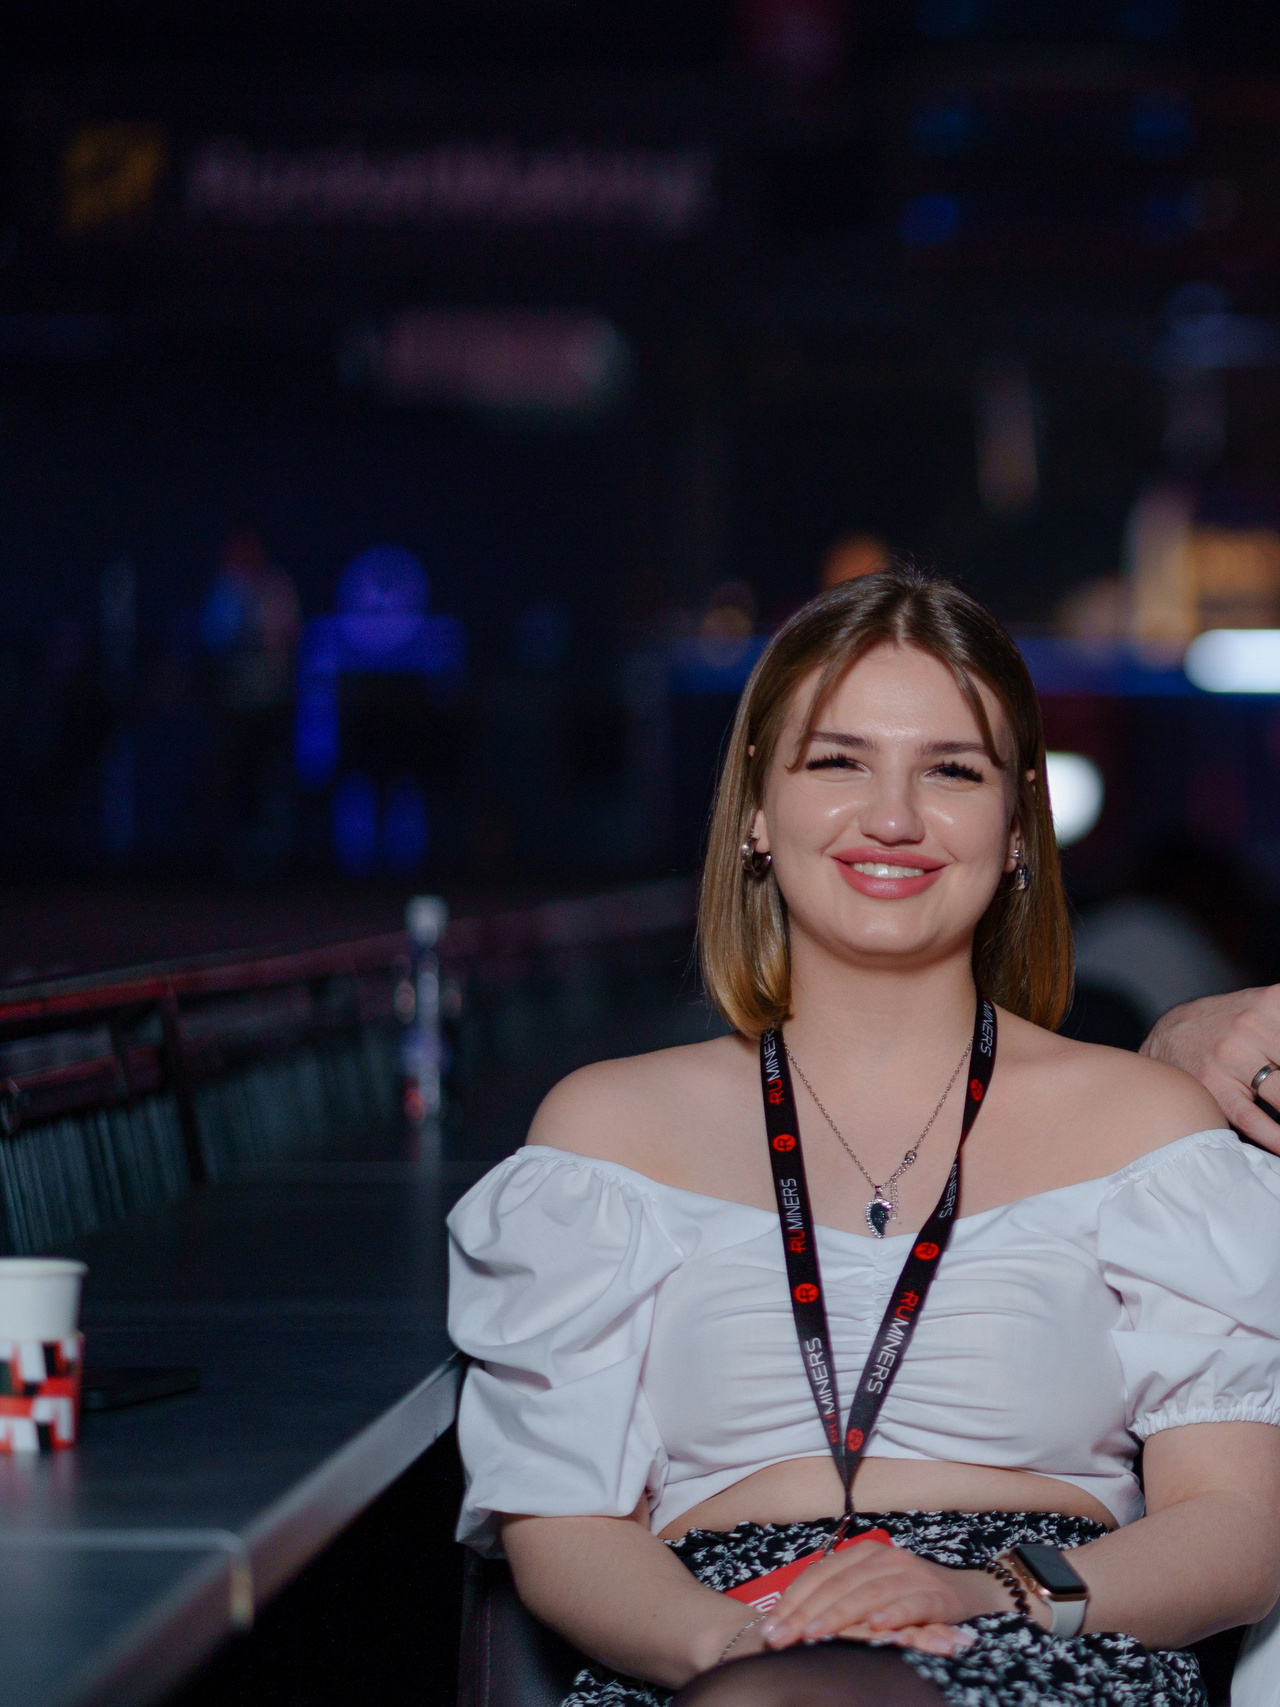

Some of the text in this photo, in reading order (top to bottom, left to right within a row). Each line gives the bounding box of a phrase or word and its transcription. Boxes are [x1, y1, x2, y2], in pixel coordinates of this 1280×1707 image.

[763, 1024, 785, 1106] RUMINER
[779, 1177, 807, 1255] RUMINERS
[867, 1289, 919, 1395] RUMINERS
